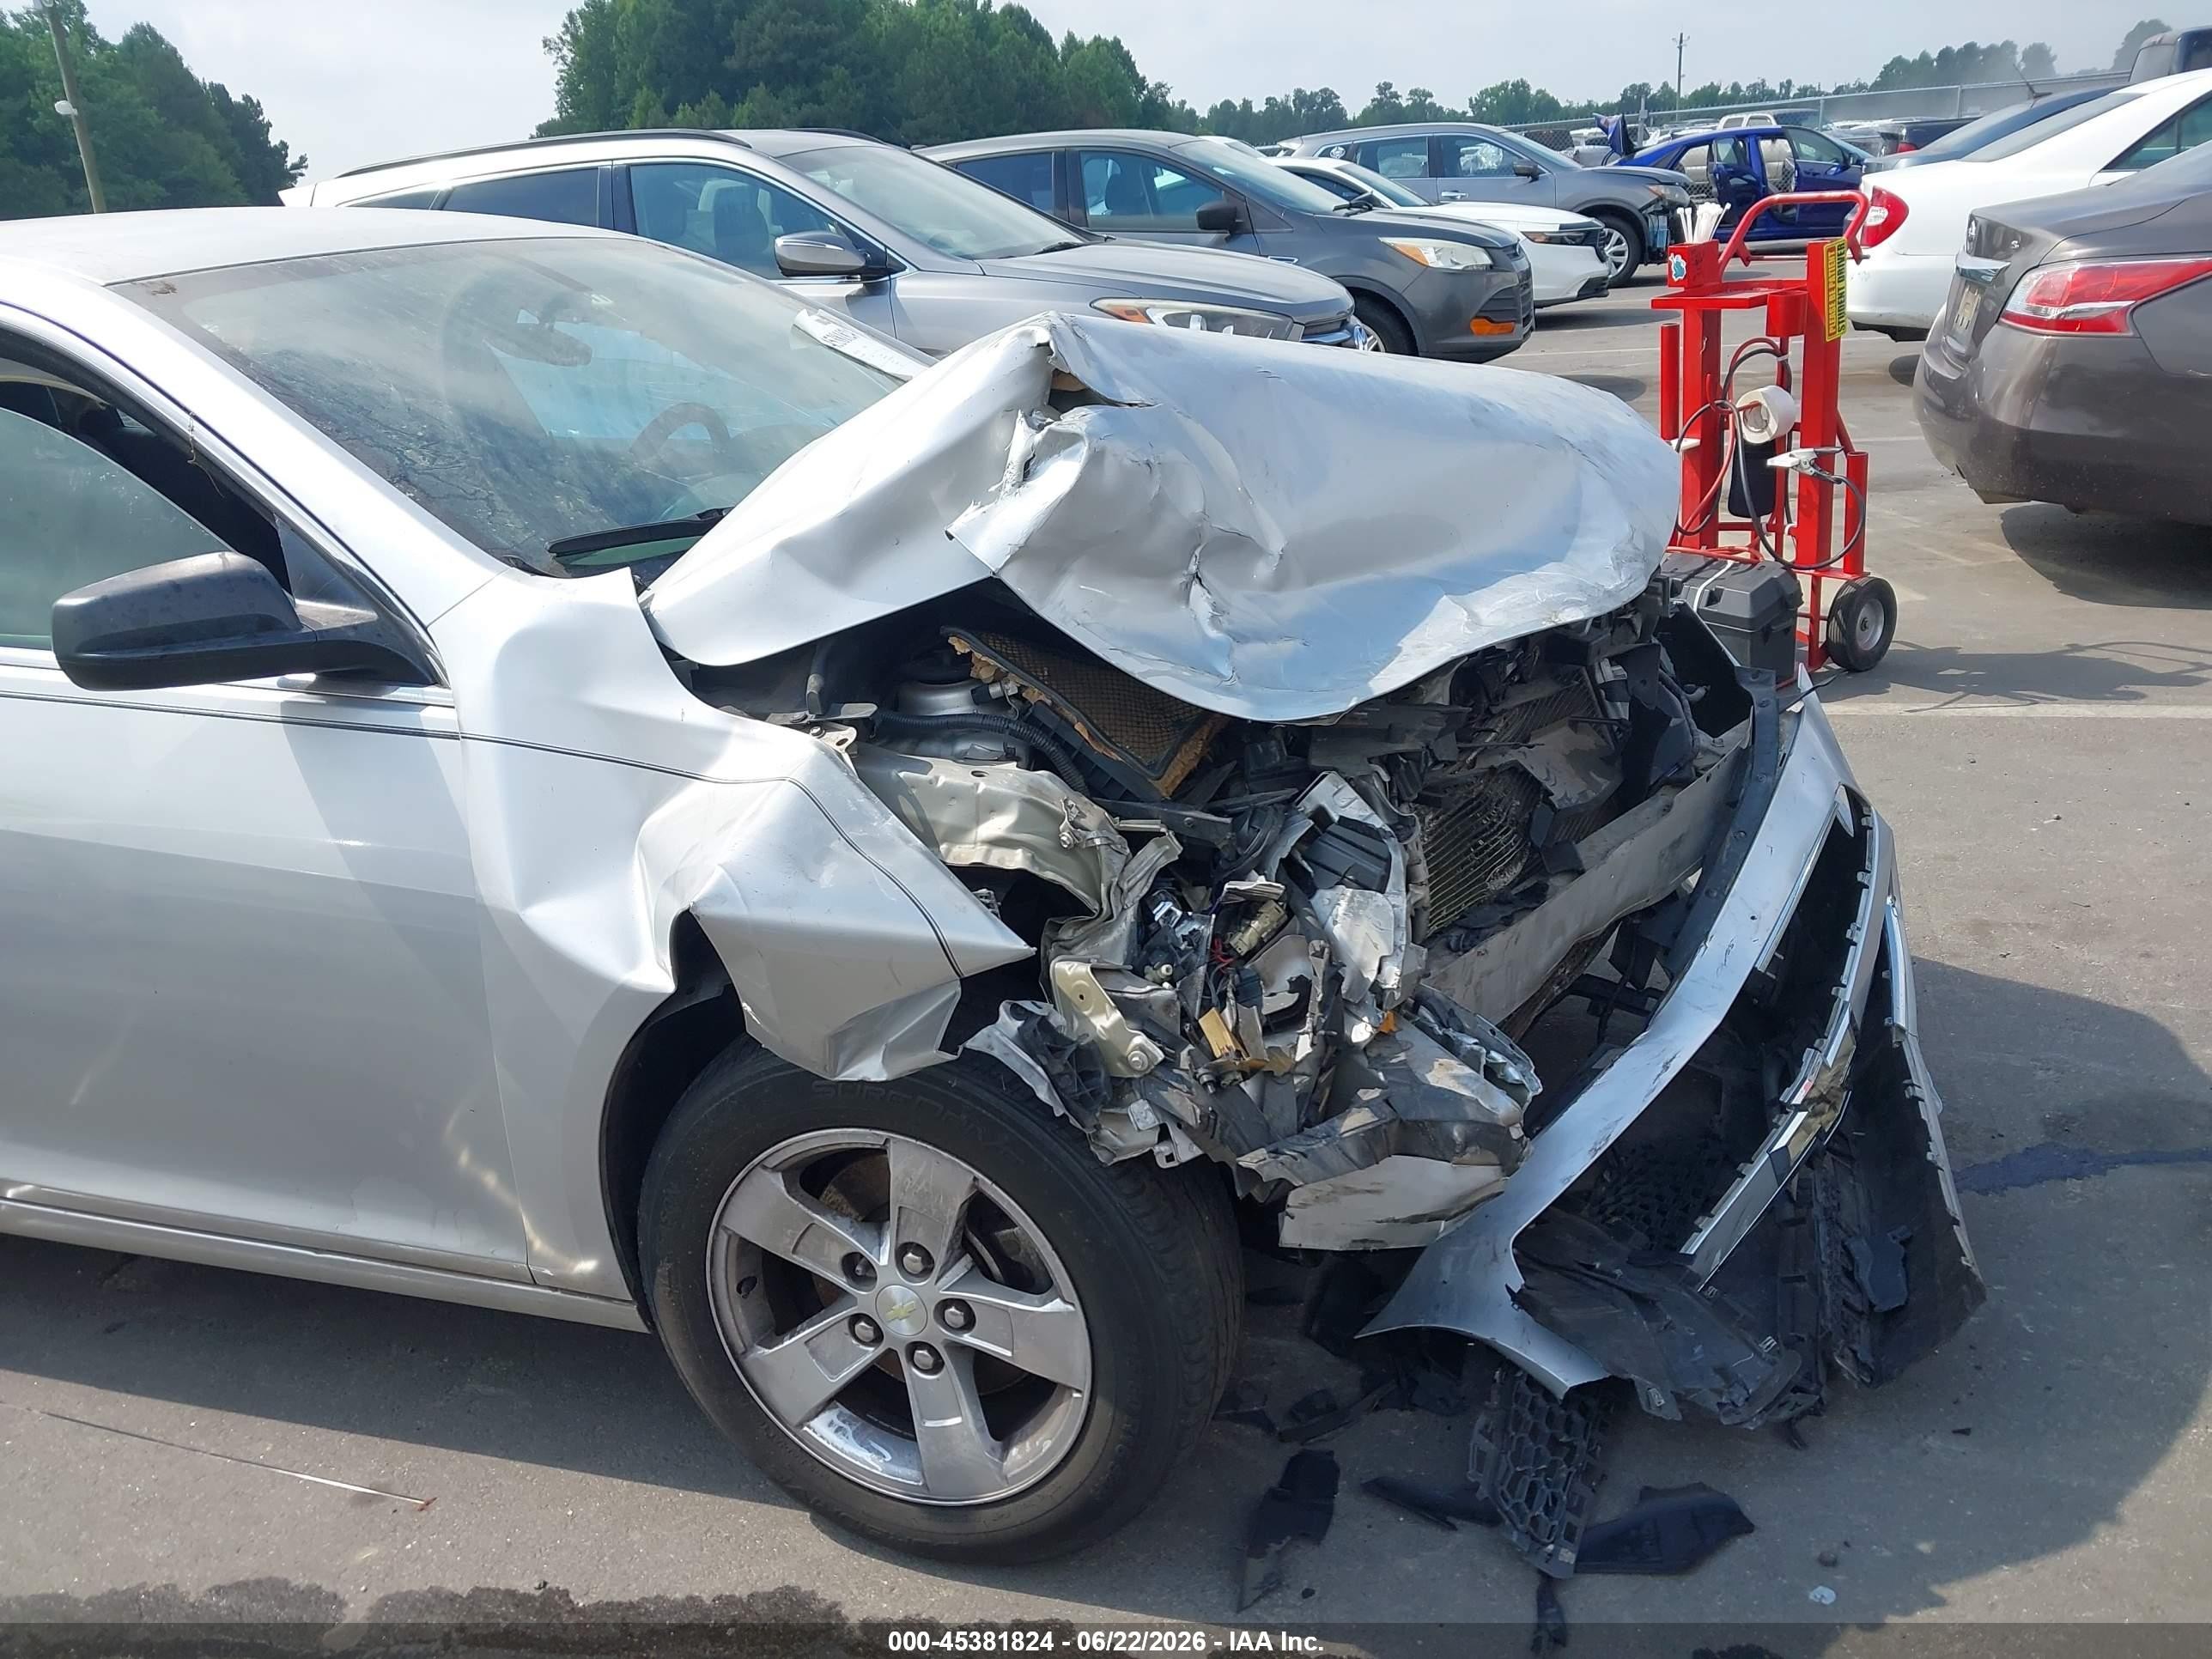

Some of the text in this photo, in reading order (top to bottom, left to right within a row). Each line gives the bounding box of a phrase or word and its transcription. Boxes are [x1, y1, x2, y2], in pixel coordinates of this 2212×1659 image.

[1827, 251, 1837, 334] PLEASE BE PATIENT
[1837, 242, 1845, 332] STUDENT DRIVER
